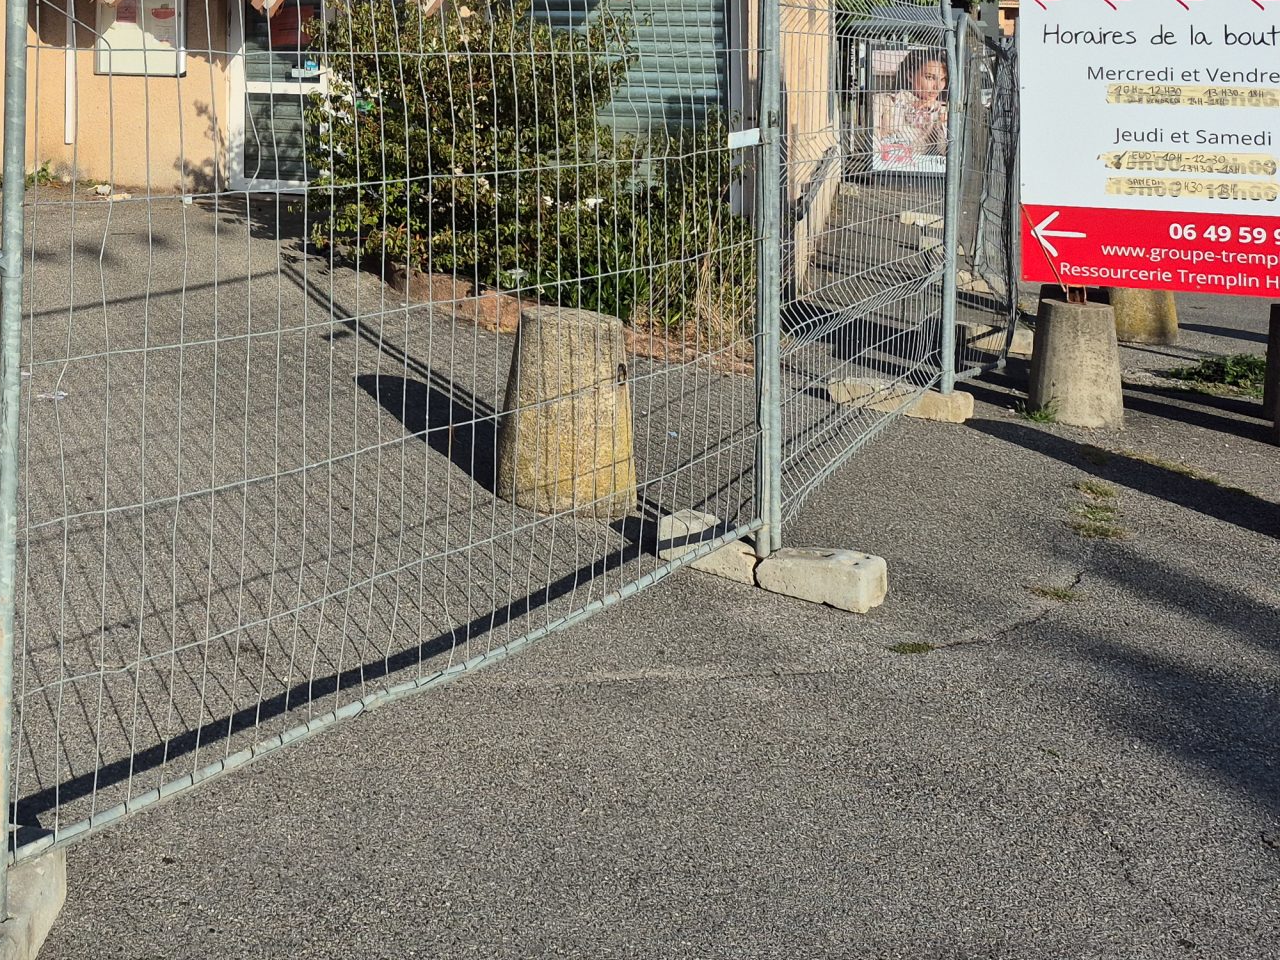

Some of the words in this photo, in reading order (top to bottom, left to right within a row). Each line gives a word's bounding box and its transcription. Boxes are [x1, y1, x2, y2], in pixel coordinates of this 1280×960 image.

[1042, 23, 1137, 46] Horaires
[1150, 24, 1178, 46] de
[1189, 24, 1213, 46] la
[1224, 24, 1280, 46] bout
[1087, 65, 1175, 82] Mercredi
[1181, 69, 1201, 83] et
[1206, 67, 1280, 84] Vendre
[1113, 127, 1163, 144] Jeudi
[1170, 130, 1190, 144] et
[1196, 129, 1272, 146] Samedi
[1168, 223, 1198, 240] 06
[1202, 225, 1232, 242] 49
[1238, 226, 1267, 244] 59
[1059, 262, 1173, 282] Ressourcerie
[1177, 269, 1260, 290] Tremplin
